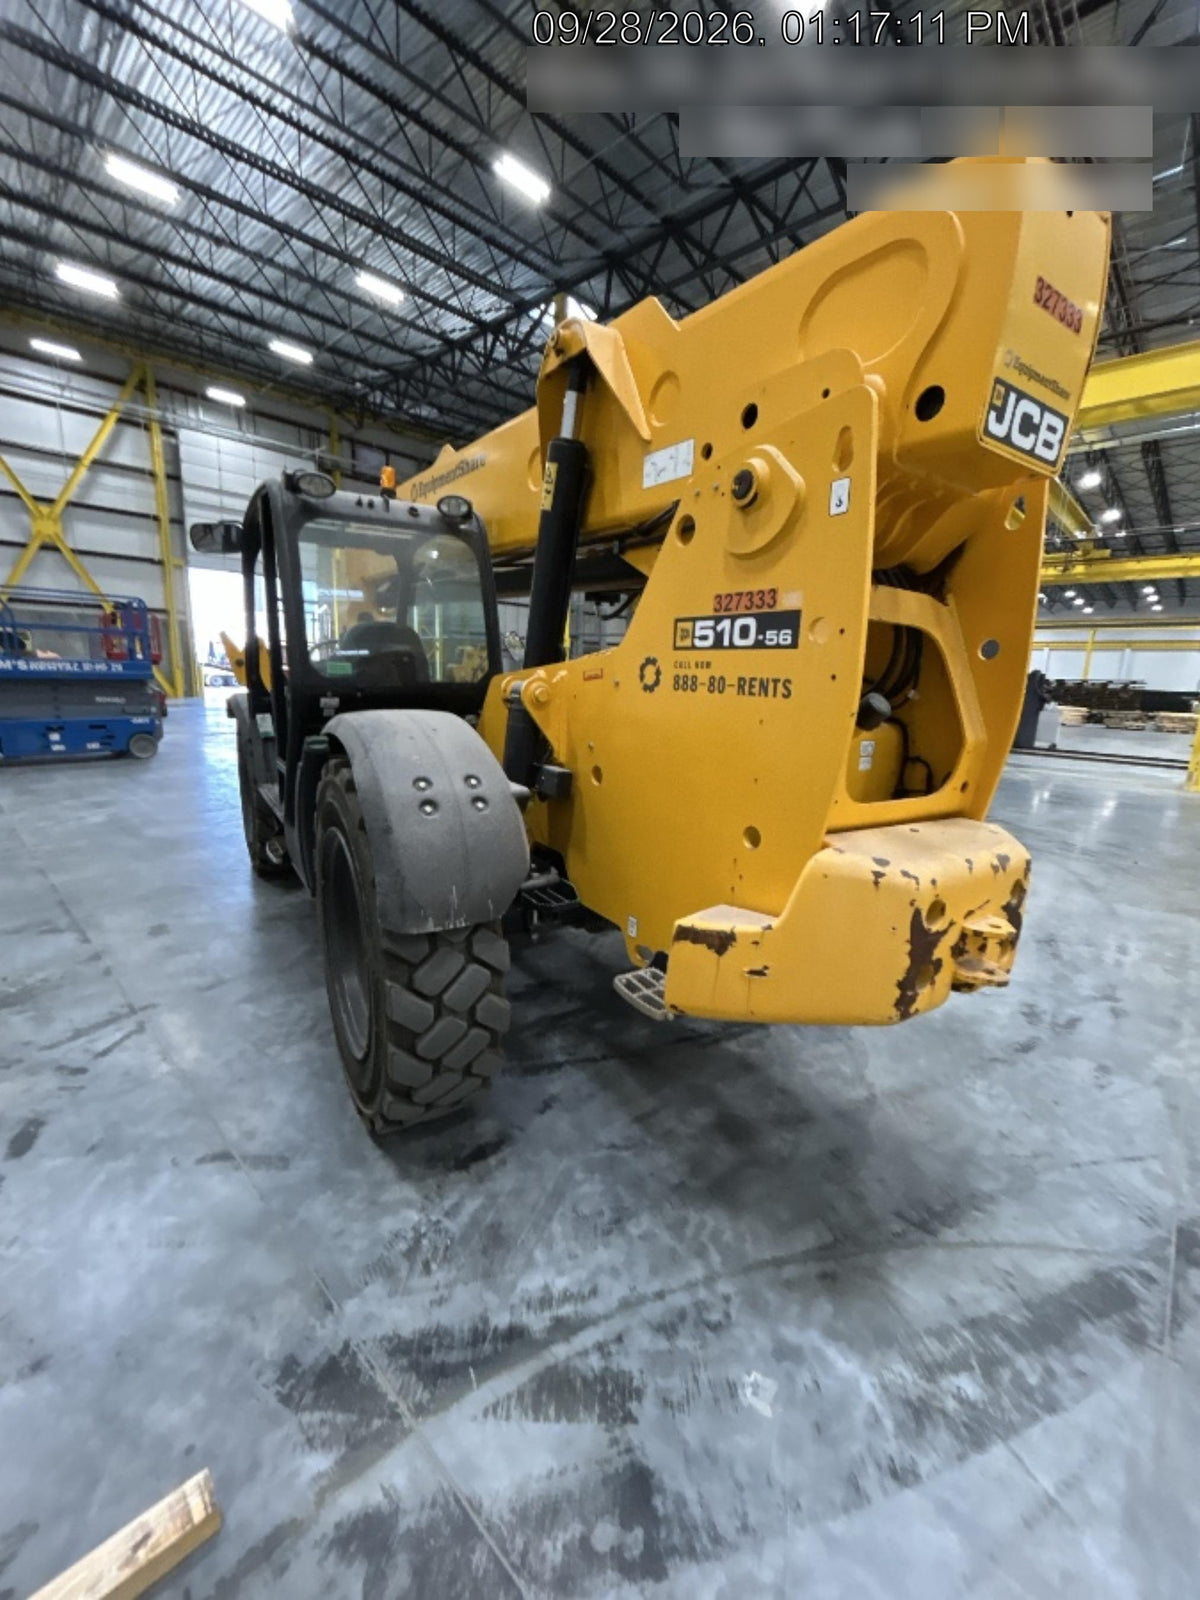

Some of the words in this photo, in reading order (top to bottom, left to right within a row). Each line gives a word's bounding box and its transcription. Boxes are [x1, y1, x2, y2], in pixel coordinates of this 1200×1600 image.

[1033, 275, 1083, 335] 327333
[987, 390, 1065, 462] JCB
[713, 588, 778, 613] 327333
[693, 616, 793, 648] 510-56
[673, 660, 692, 669] CALL
[694, 660, 712, 669] NOW
[673, 674, 793, 699] 888-80-RENTS
